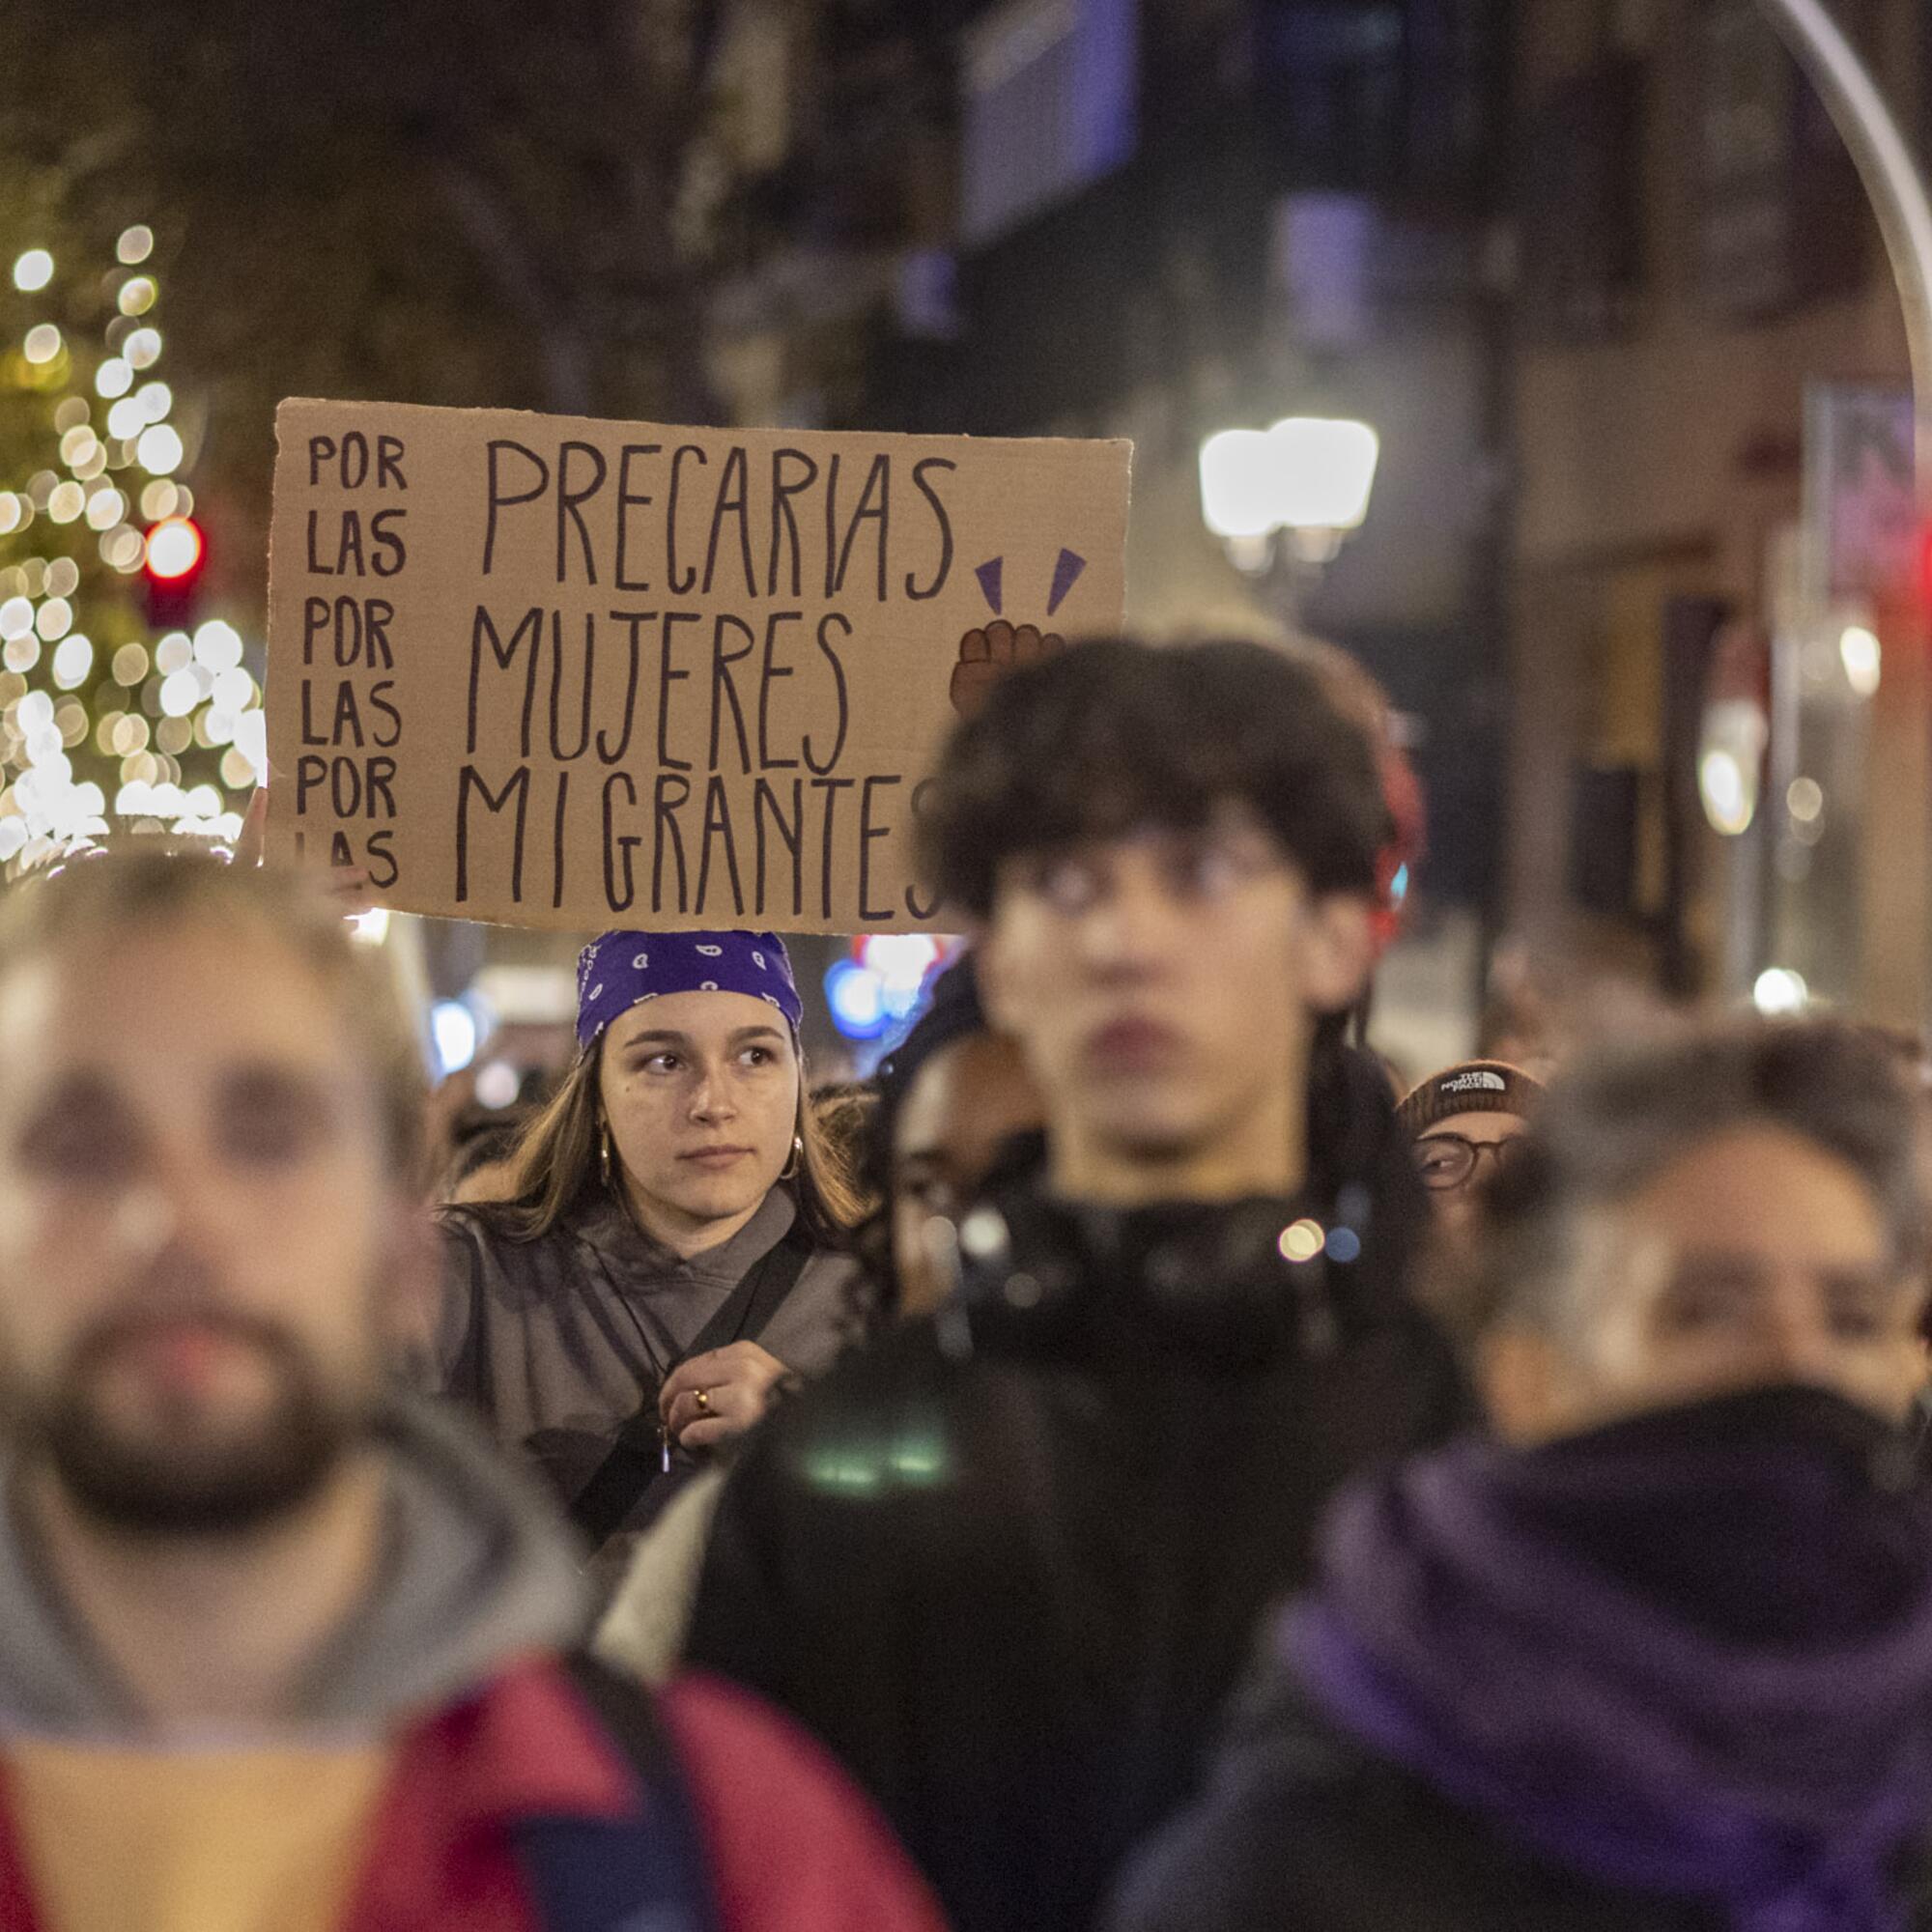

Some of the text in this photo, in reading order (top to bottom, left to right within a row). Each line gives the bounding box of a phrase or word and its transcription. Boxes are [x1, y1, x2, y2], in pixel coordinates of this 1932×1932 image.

[308, 431, 408, 491] POR
[307, 509, 408, 577] LAS
[483, 439, 957, 603] PRECARIAS
[302, 595, 395, 669] POR
[301, 679, 402, 748] LAS
[467, 605, 853, 776] MUJERES
[297, 754, 397, 819] POR
